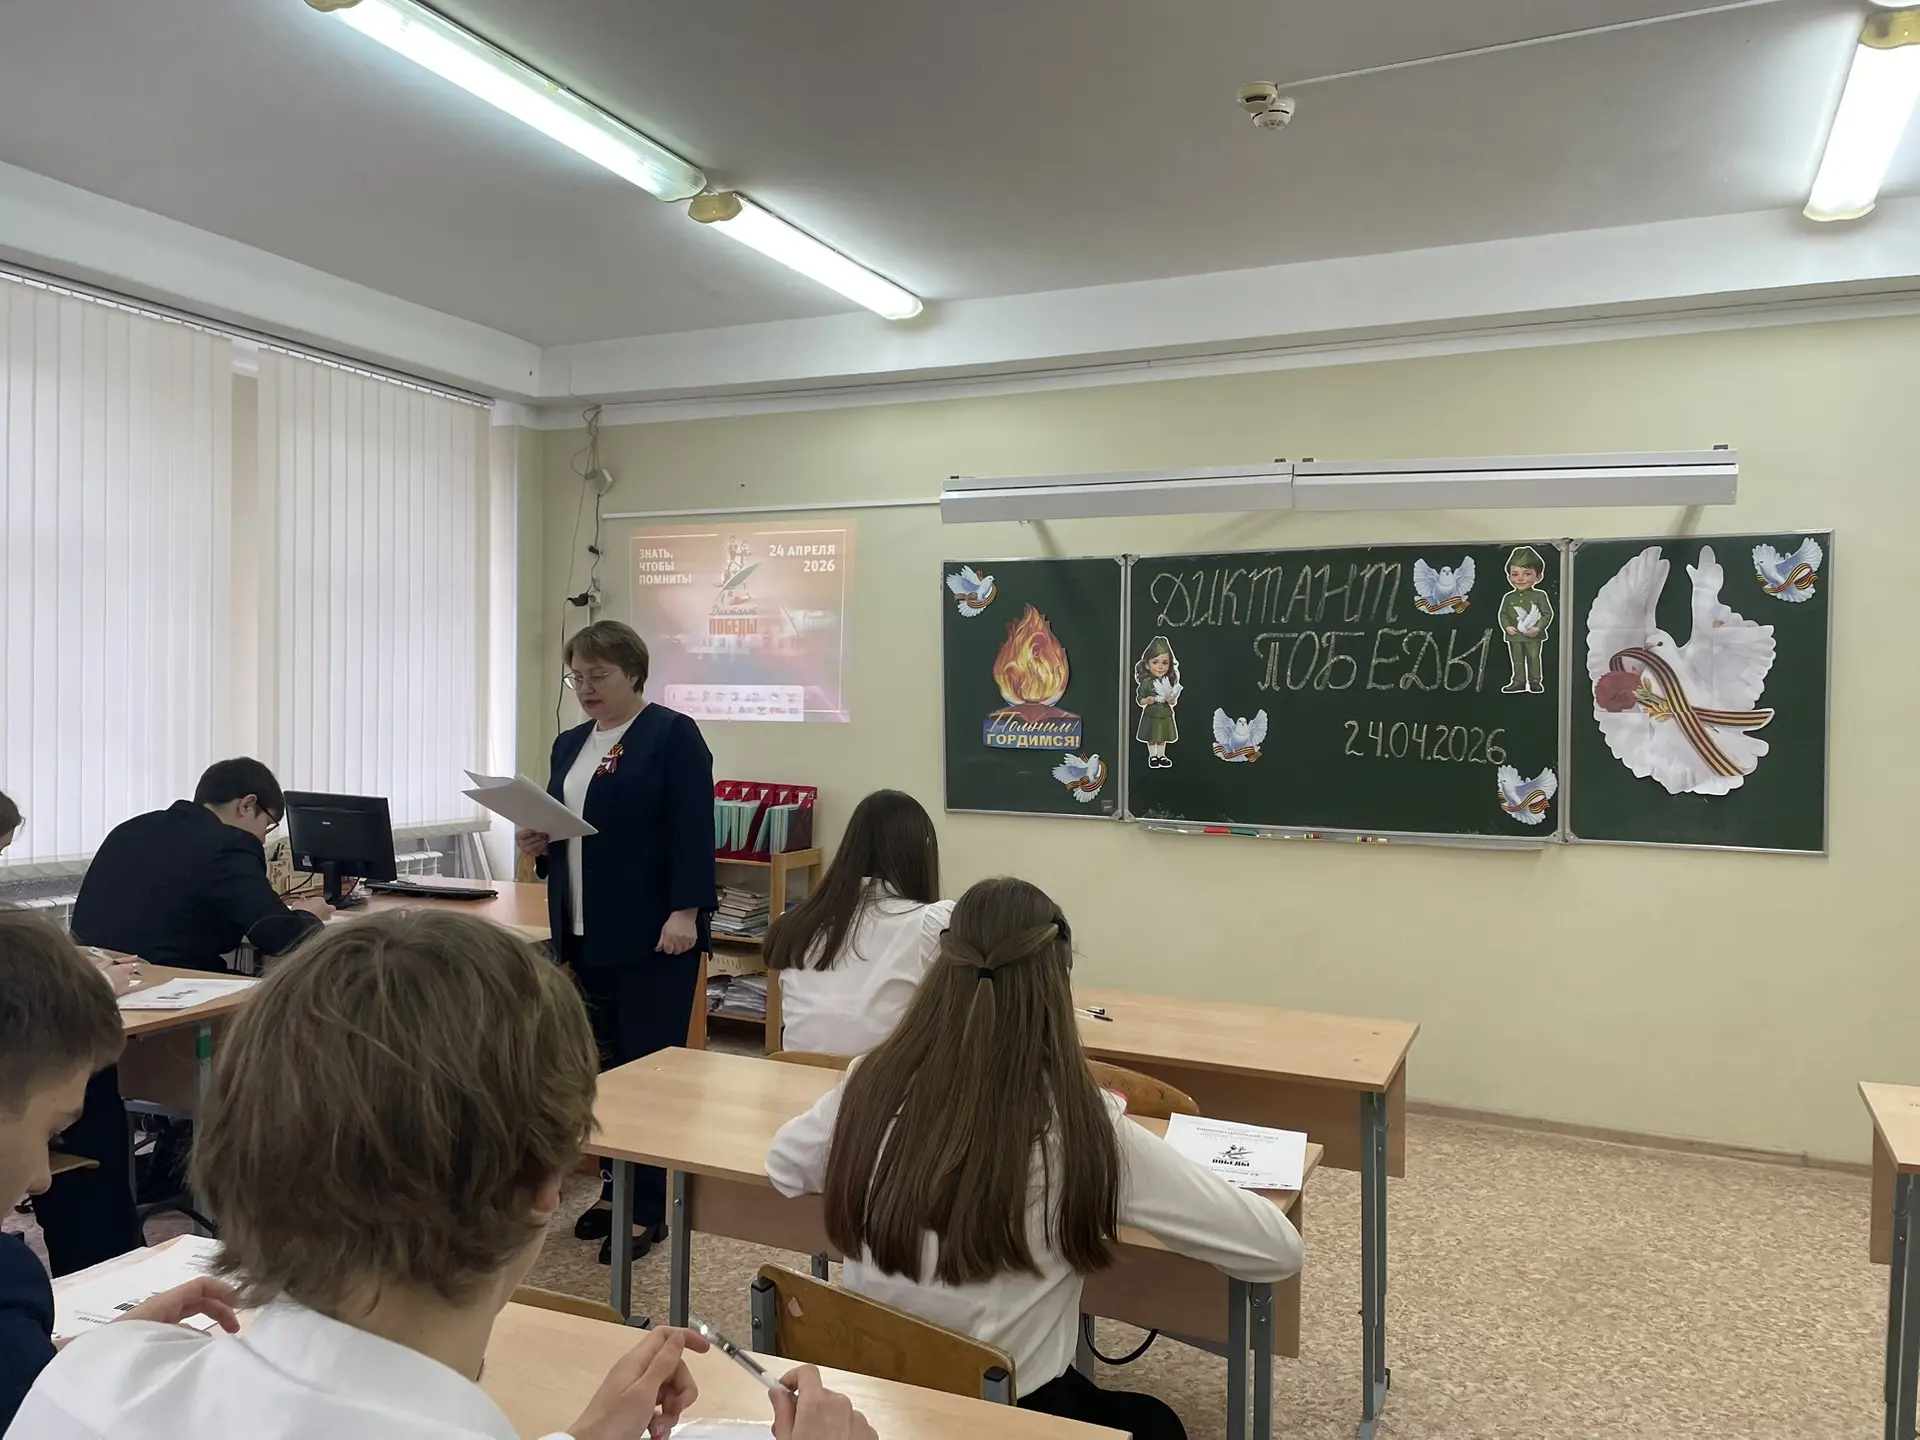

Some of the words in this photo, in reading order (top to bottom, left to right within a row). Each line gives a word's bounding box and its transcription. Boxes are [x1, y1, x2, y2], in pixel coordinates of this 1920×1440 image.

[639, 548, 673, 559] ЗНАТЬ,
[768, 544, 784, 557] 24
[787, 544, 836, 556] АПРЕЛЯ
[639, 561, 675, 572] ЧТОБЫ
[803, 559, 836, 572] 2026
[1150, 562, 1401, 627] ДИКТАНТ
[709, 618, 758, 637] ПОБЕДЫ
[1253, 627, 1493, 692] ПОБЕДЫ
[986, 734, 1080, 748] ГОРДИМСЯ!
[1344, 720, 1507, 765] 24.04.2026
